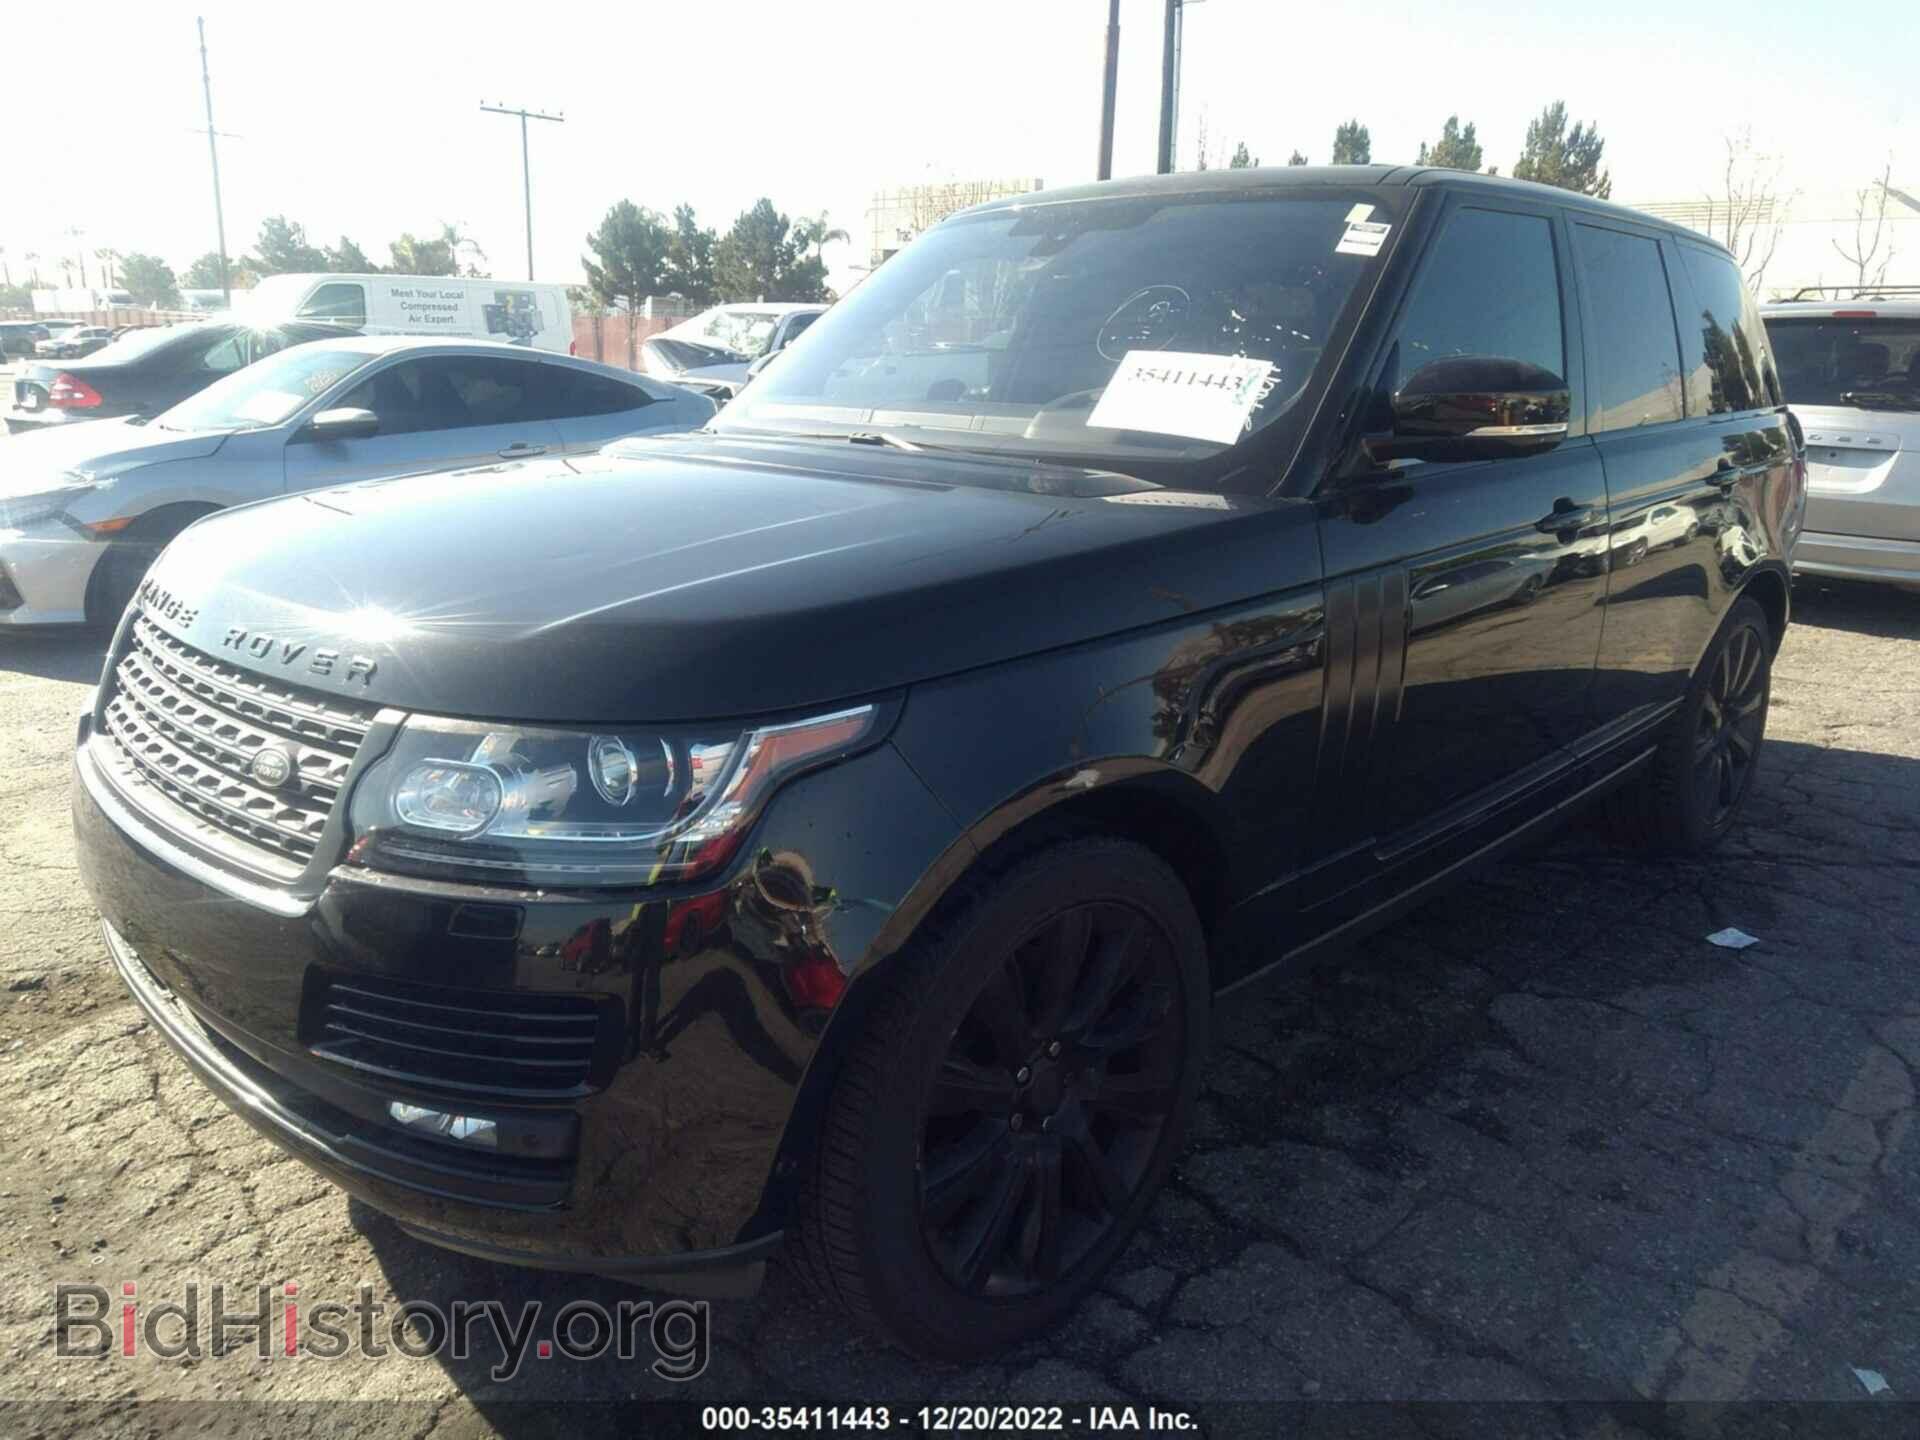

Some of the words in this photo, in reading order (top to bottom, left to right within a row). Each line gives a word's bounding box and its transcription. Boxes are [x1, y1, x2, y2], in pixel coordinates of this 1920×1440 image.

[391, 288, 414, 297] Meet
[416, 289, 437, 298] Your
[439, 290, 465, 299] Local
[400, 301, 458, 311] Compressed
[408, 314, 422, 323] Air
[1127, 367, 1244, 391] 35411443
[223, 625, 378, 688] ROVER
